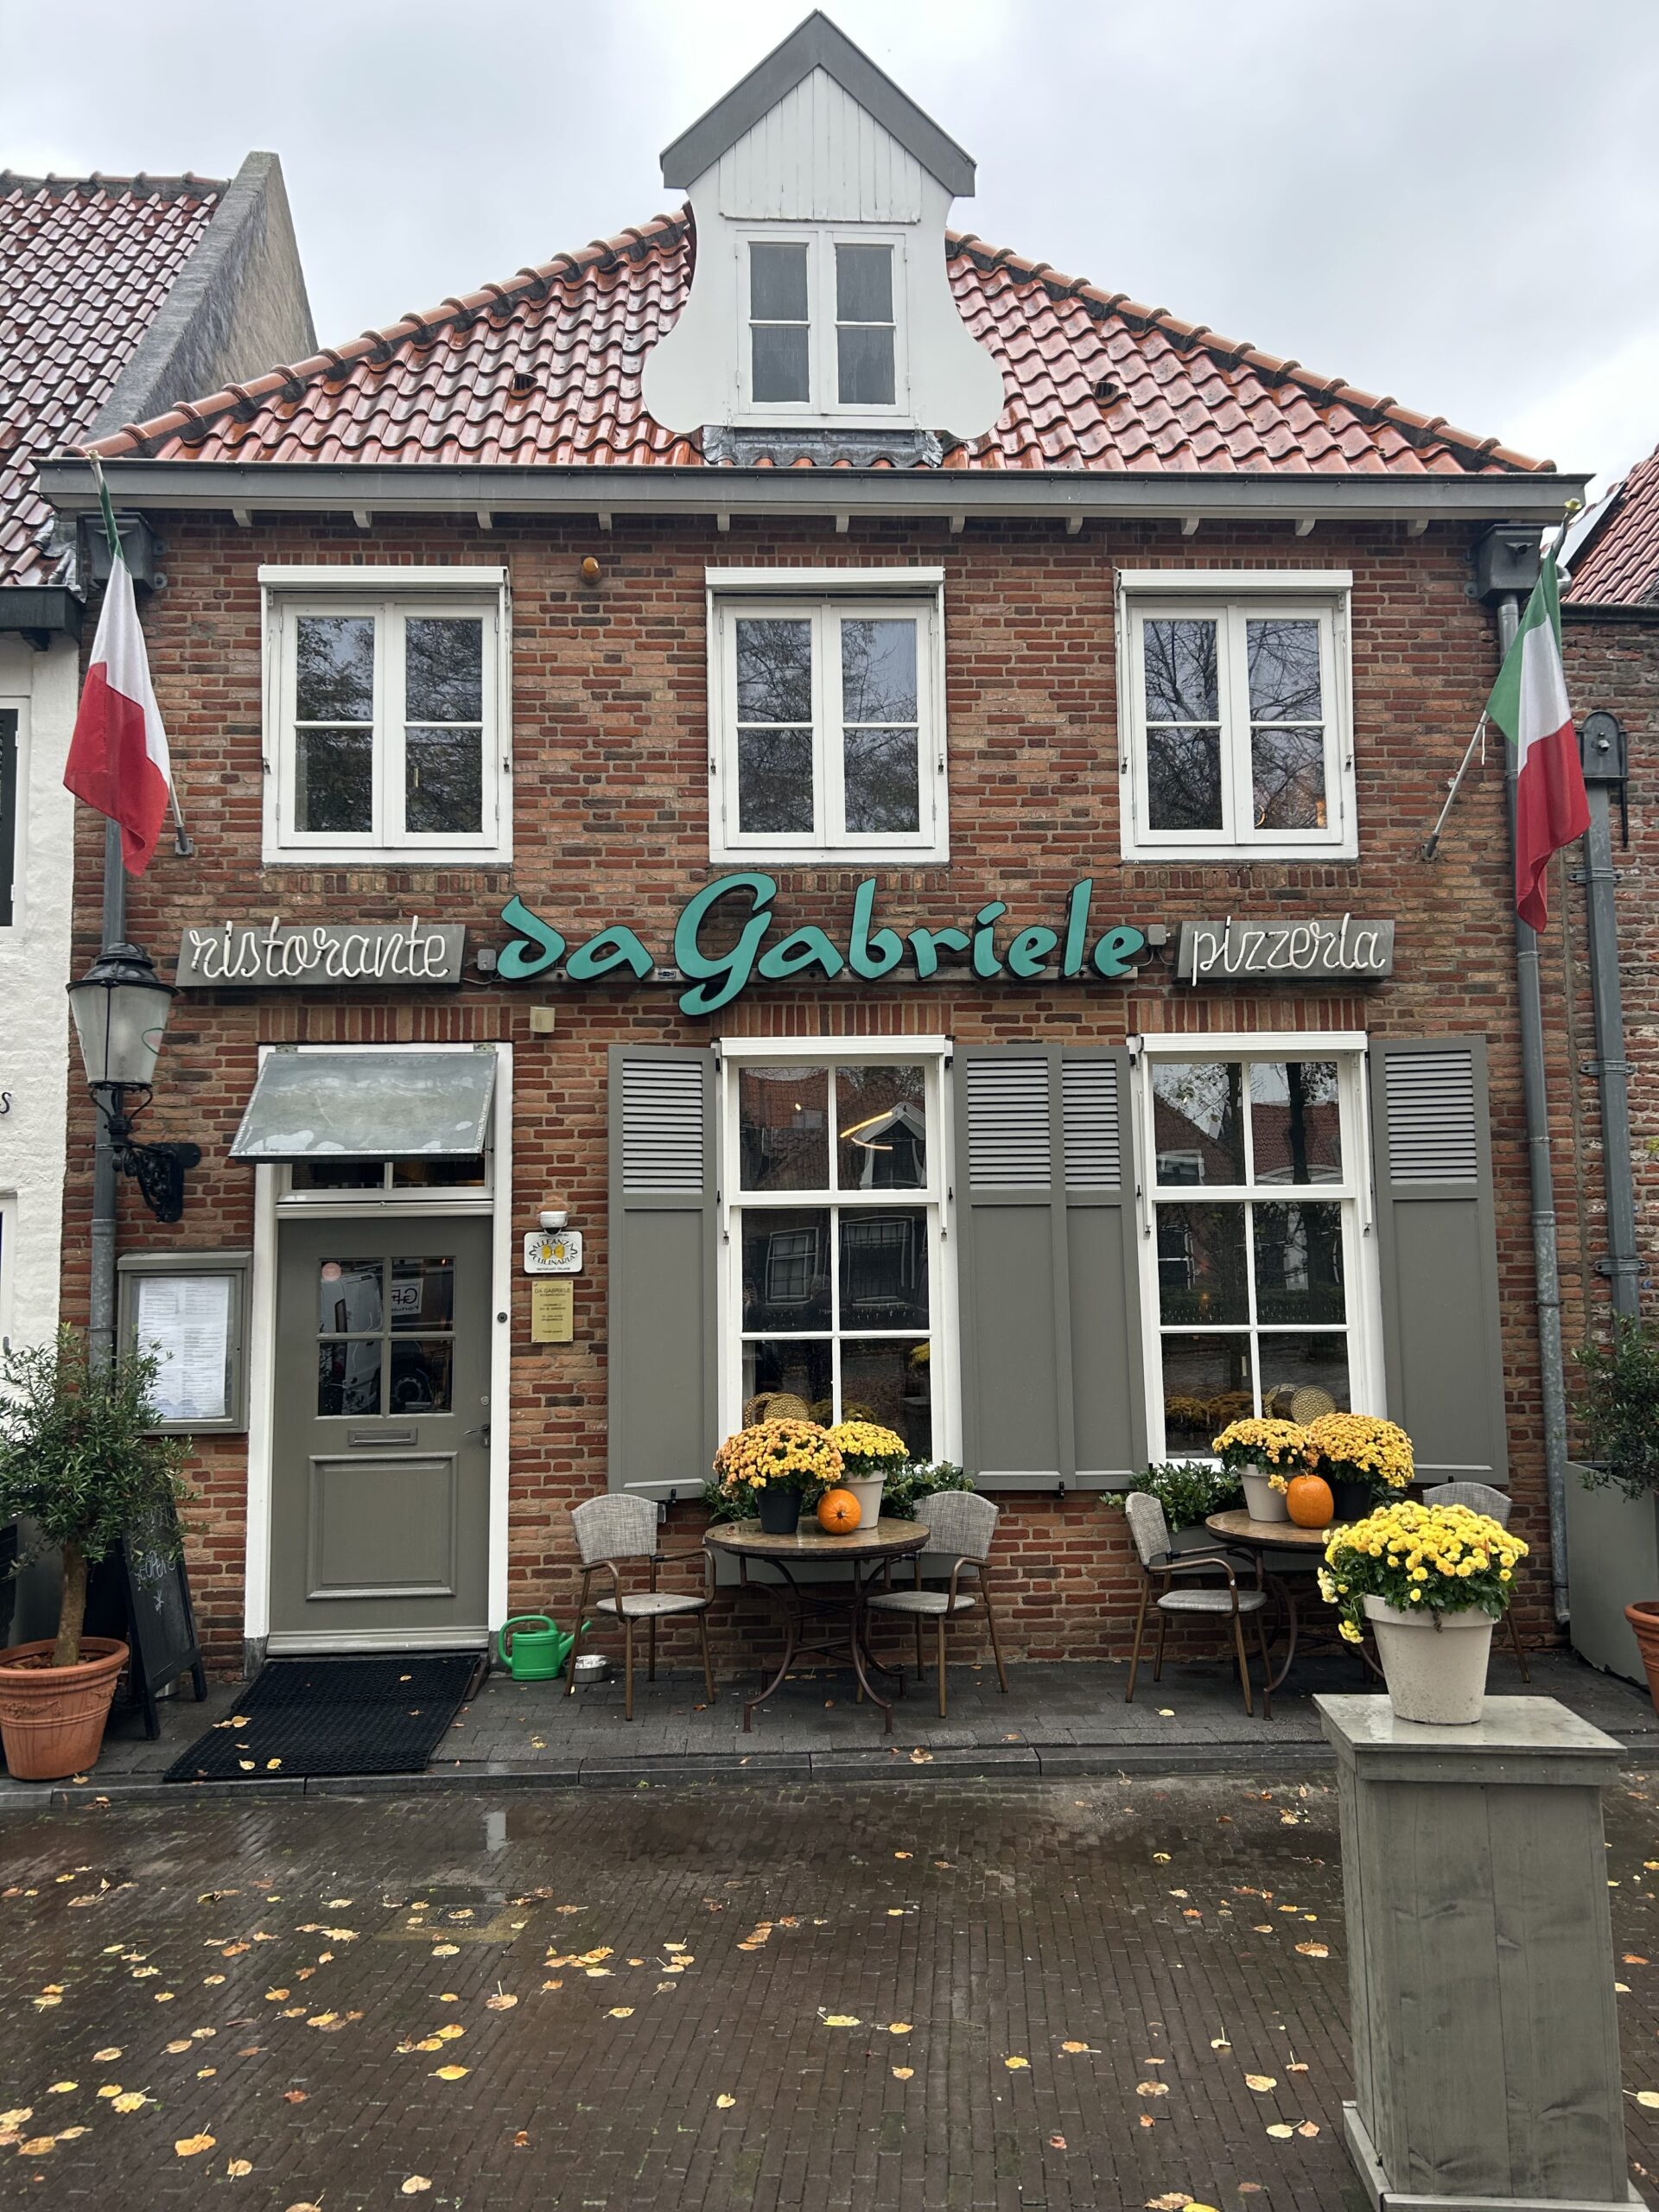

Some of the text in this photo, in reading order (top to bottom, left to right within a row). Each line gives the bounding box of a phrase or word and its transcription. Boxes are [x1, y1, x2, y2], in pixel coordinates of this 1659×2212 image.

[188, 915, 449, 979] ristorante
[497, 871, 1146, 1016] da Gabriele
[1191, 912, 1386, 987] pizzeria
[532, 1238, 575, 1250] ALLEANZA
[532, 1255, 575, 1266] CULINARIA
